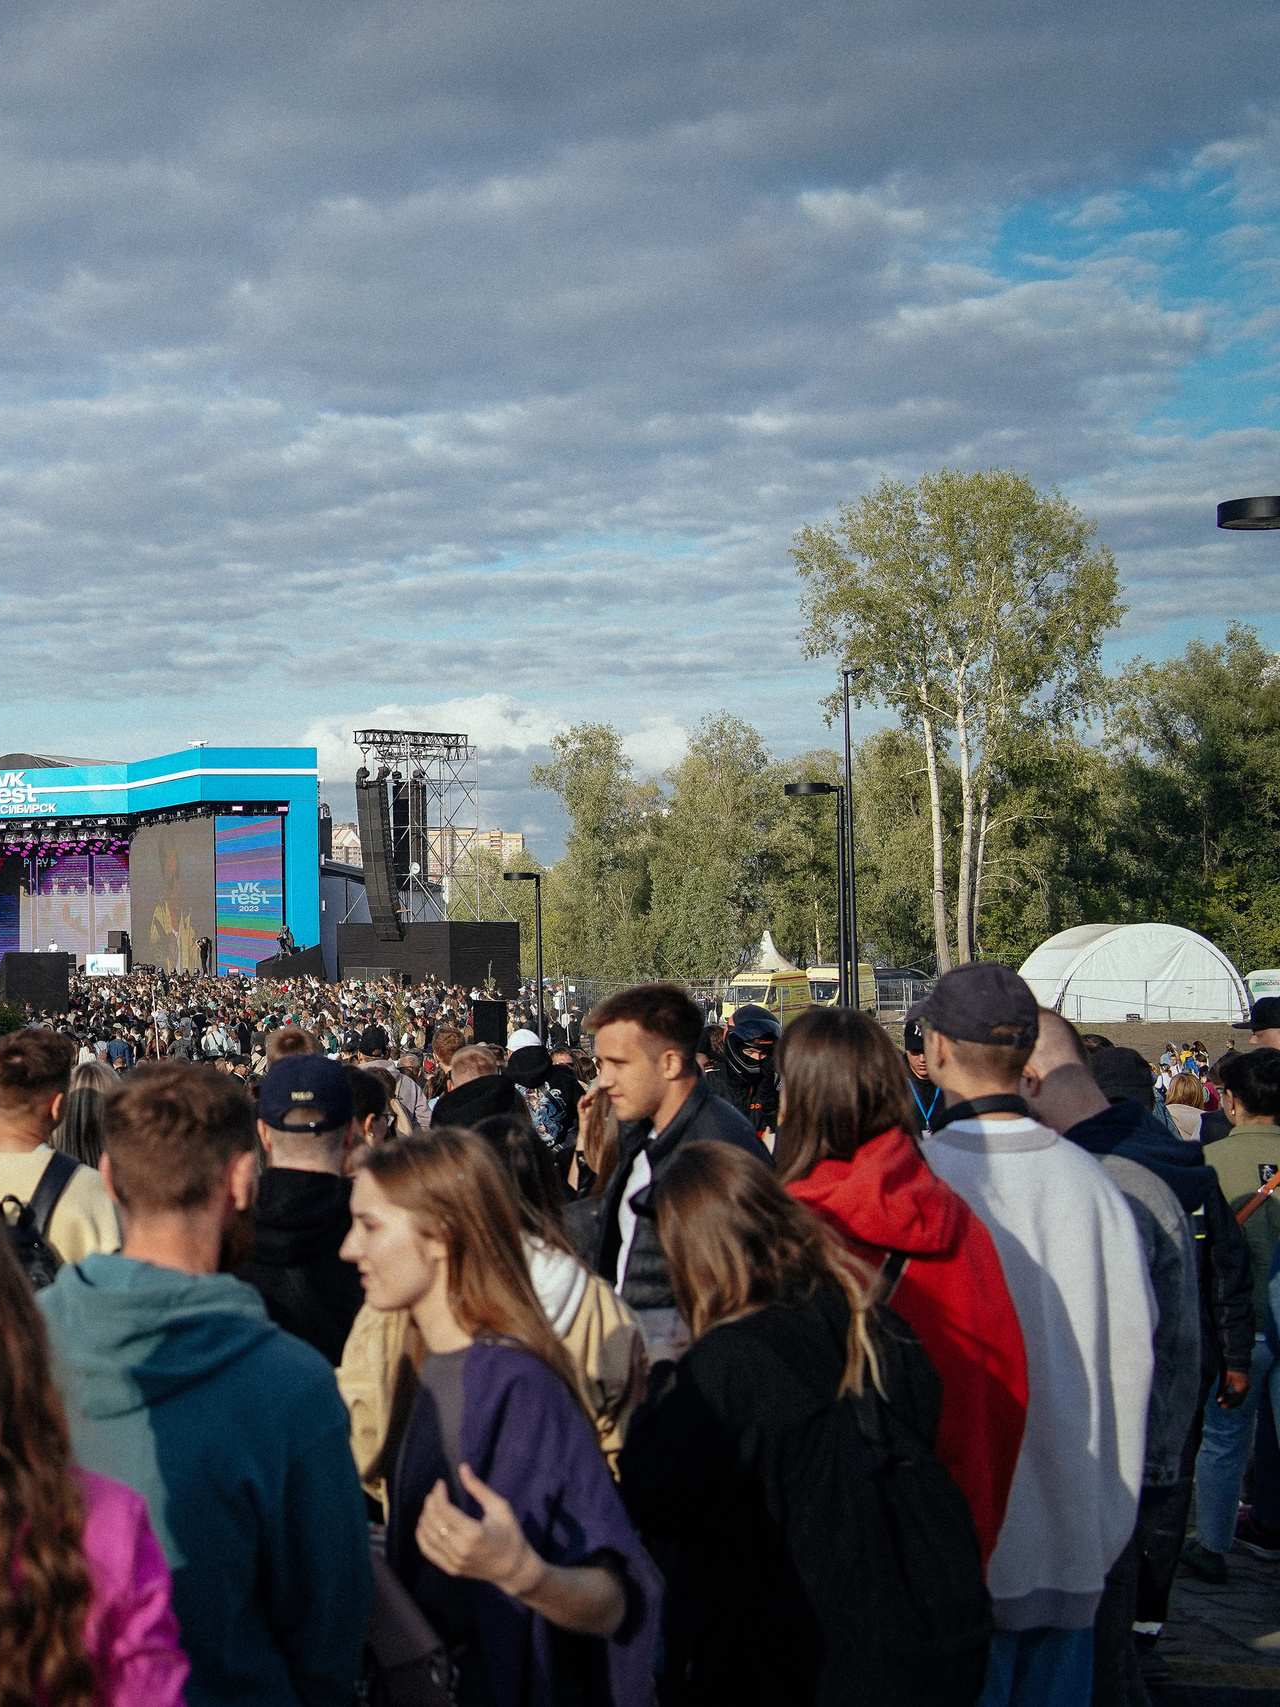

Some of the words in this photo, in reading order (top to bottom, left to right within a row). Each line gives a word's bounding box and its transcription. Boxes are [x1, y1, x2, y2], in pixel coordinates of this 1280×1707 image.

[23, 858, 49, 867] PAY
[237, 882, 261, 893] VK
[231, 890, 269, 904] fest
